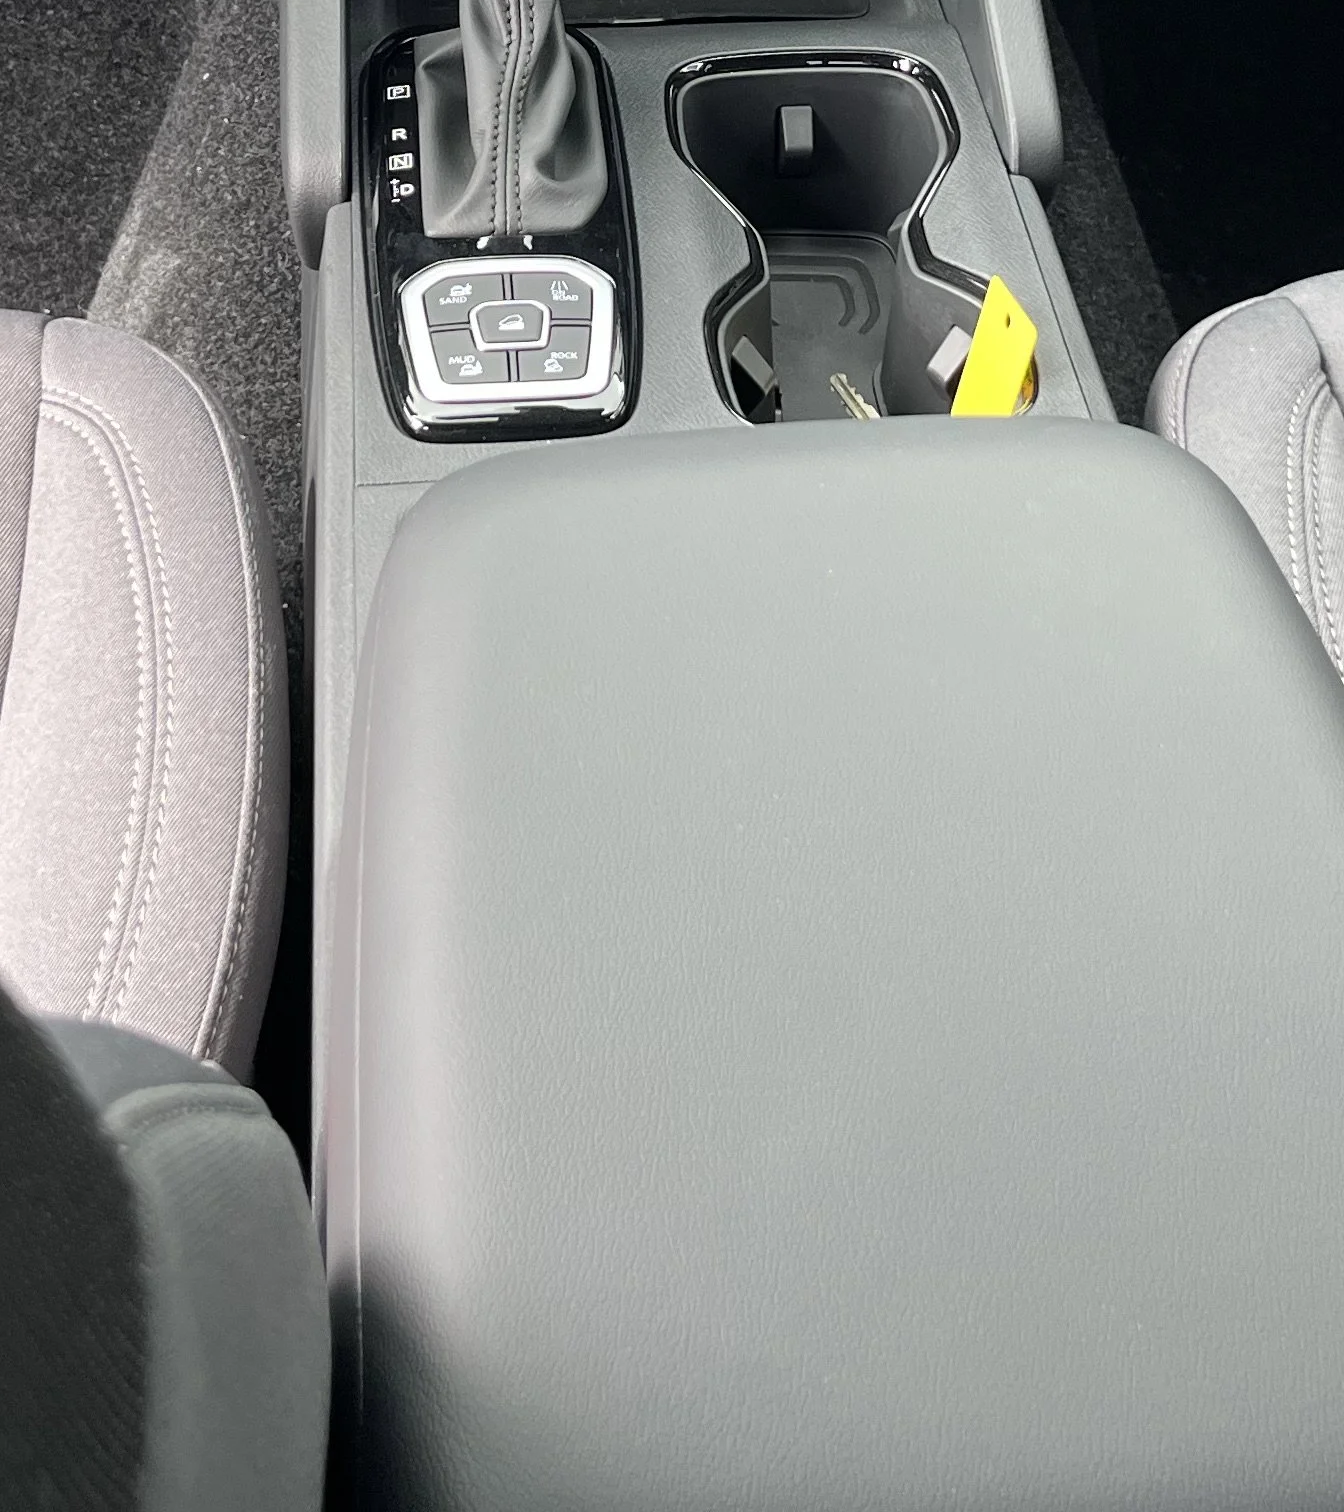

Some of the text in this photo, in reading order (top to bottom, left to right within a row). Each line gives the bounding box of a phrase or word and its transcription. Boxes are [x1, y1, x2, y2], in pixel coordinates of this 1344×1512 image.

[391, 128, 408, 141] R
[400, 183, 415, 197] D
[439, 295, 468, 306] SAND
[448, 354, 475, 365] MUD
[550, 351, 579, 359] ROCK
